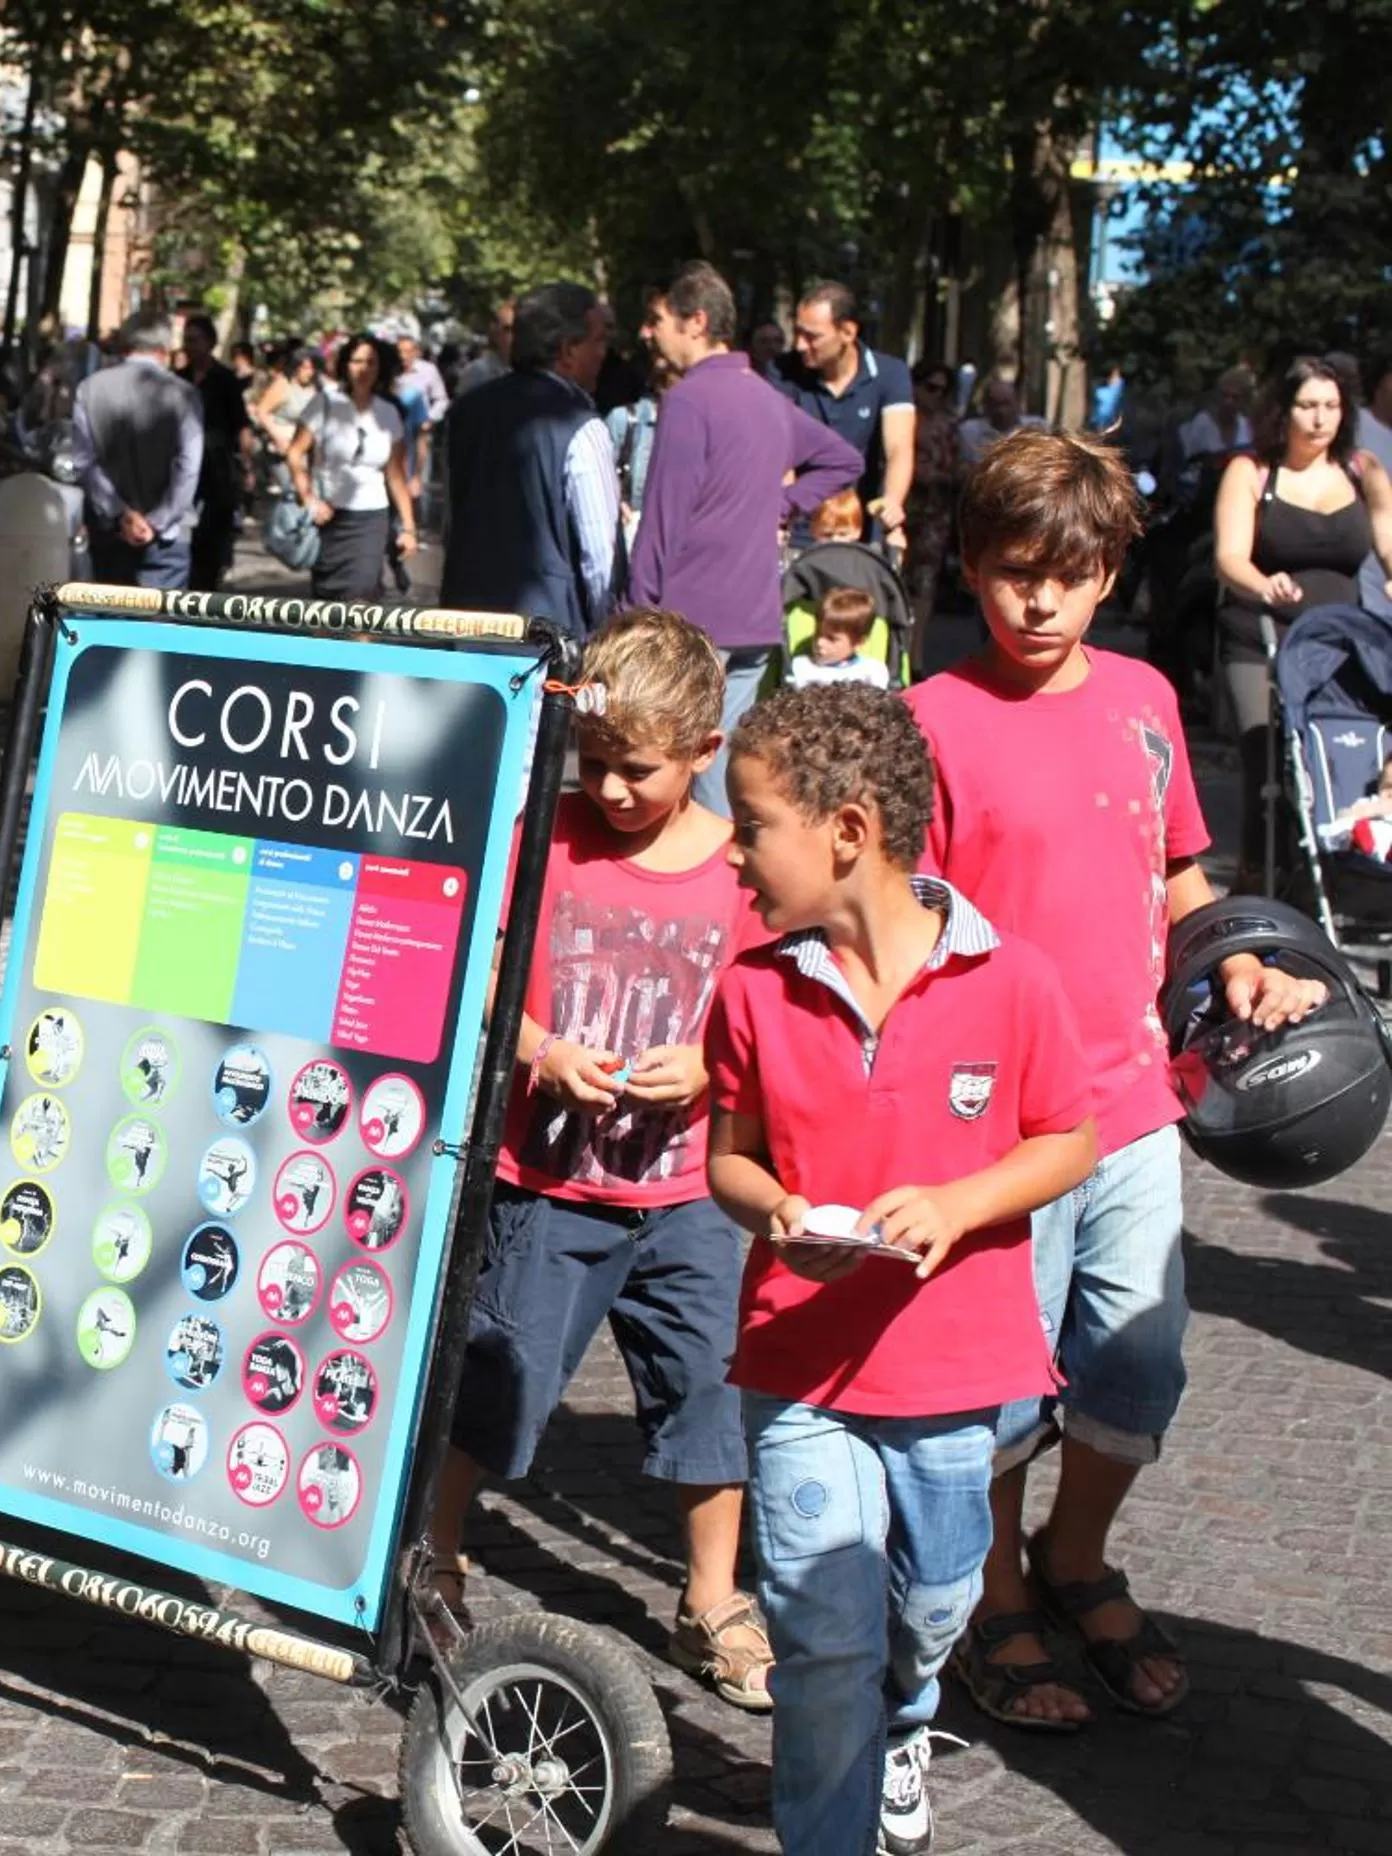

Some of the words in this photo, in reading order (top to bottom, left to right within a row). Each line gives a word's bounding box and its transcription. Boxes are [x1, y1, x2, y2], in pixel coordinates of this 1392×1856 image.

[168, 679, 385, 769] CORSI
[73, 752, 312, 822] MOVIMENTO
[322, 784, 454, 844] DANZA
[23, 1463, 271, 1558] www.movimentodanza.org
